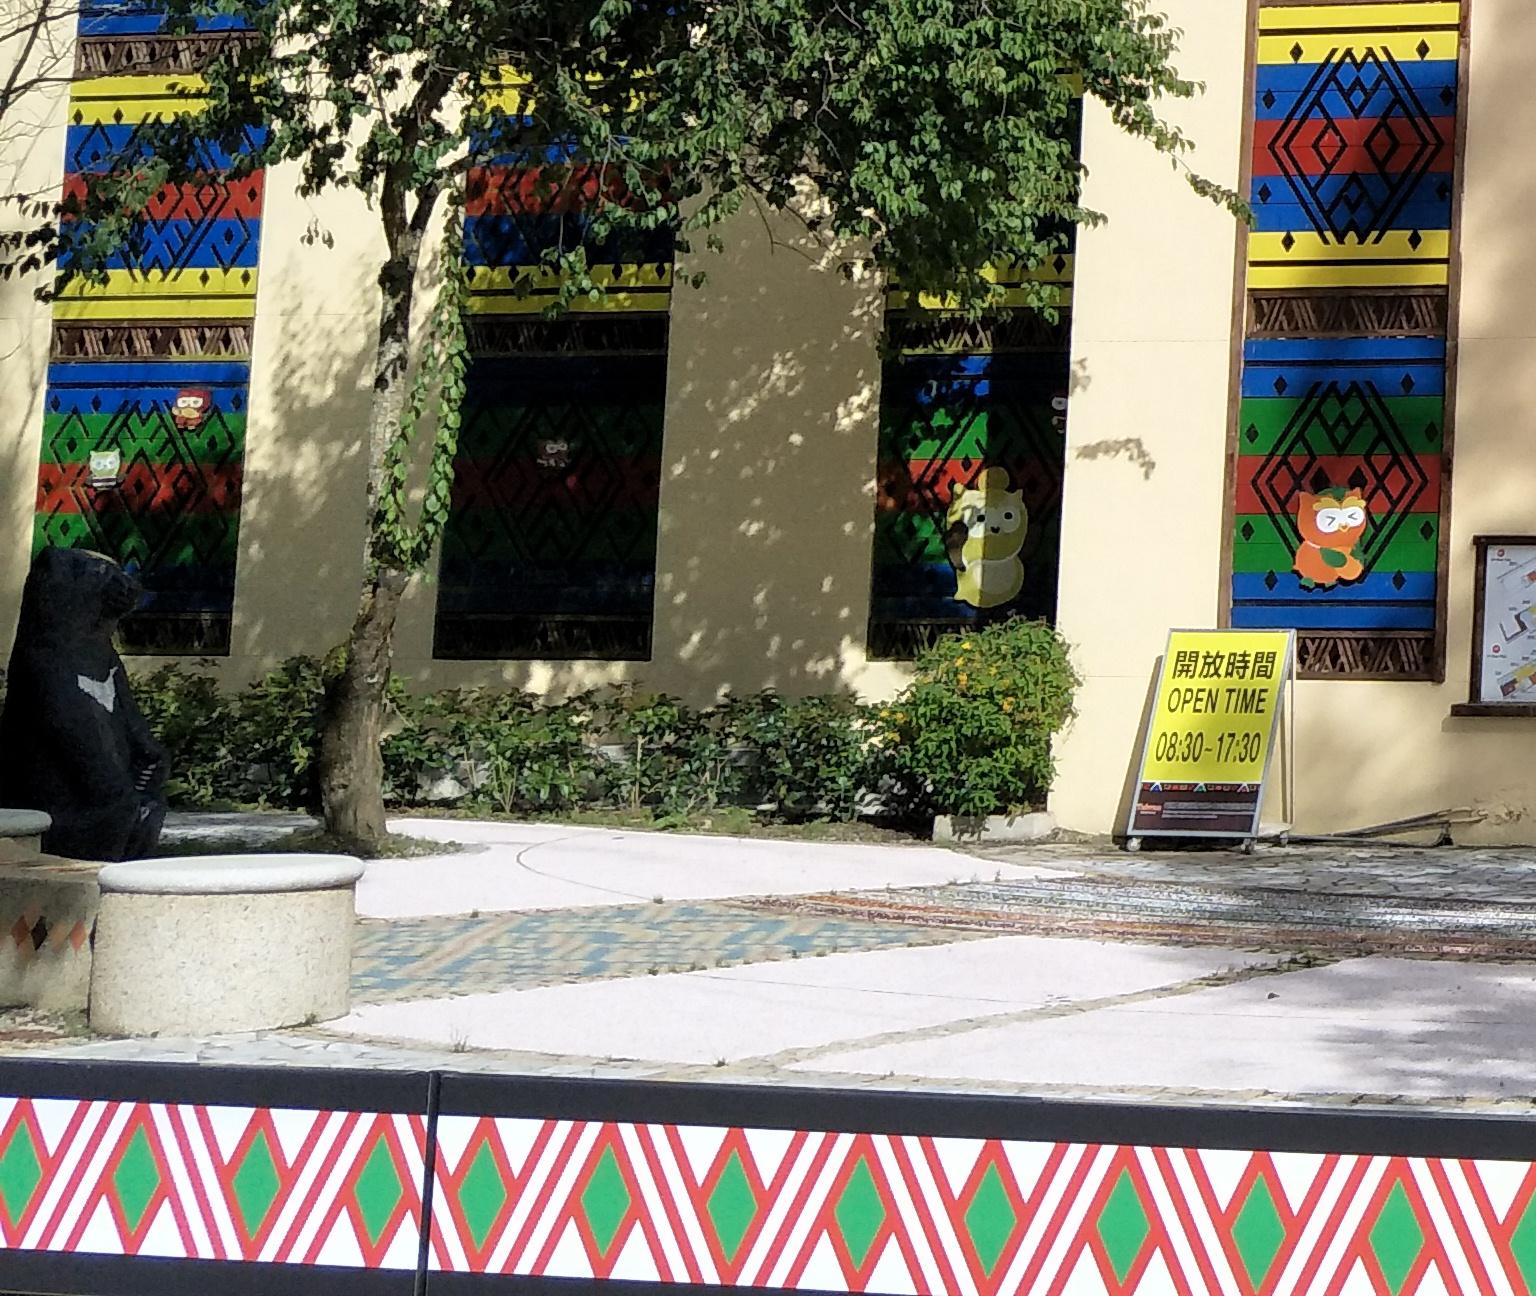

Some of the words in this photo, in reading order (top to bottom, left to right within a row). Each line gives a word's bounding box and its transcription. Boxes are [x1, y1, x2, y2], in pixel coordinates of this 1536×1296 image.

[1171, 650, 1278, 681] 開放時間
[1168, 688, 1220, 714] OPEN
[1224, 688, 1268, 714] TIME
